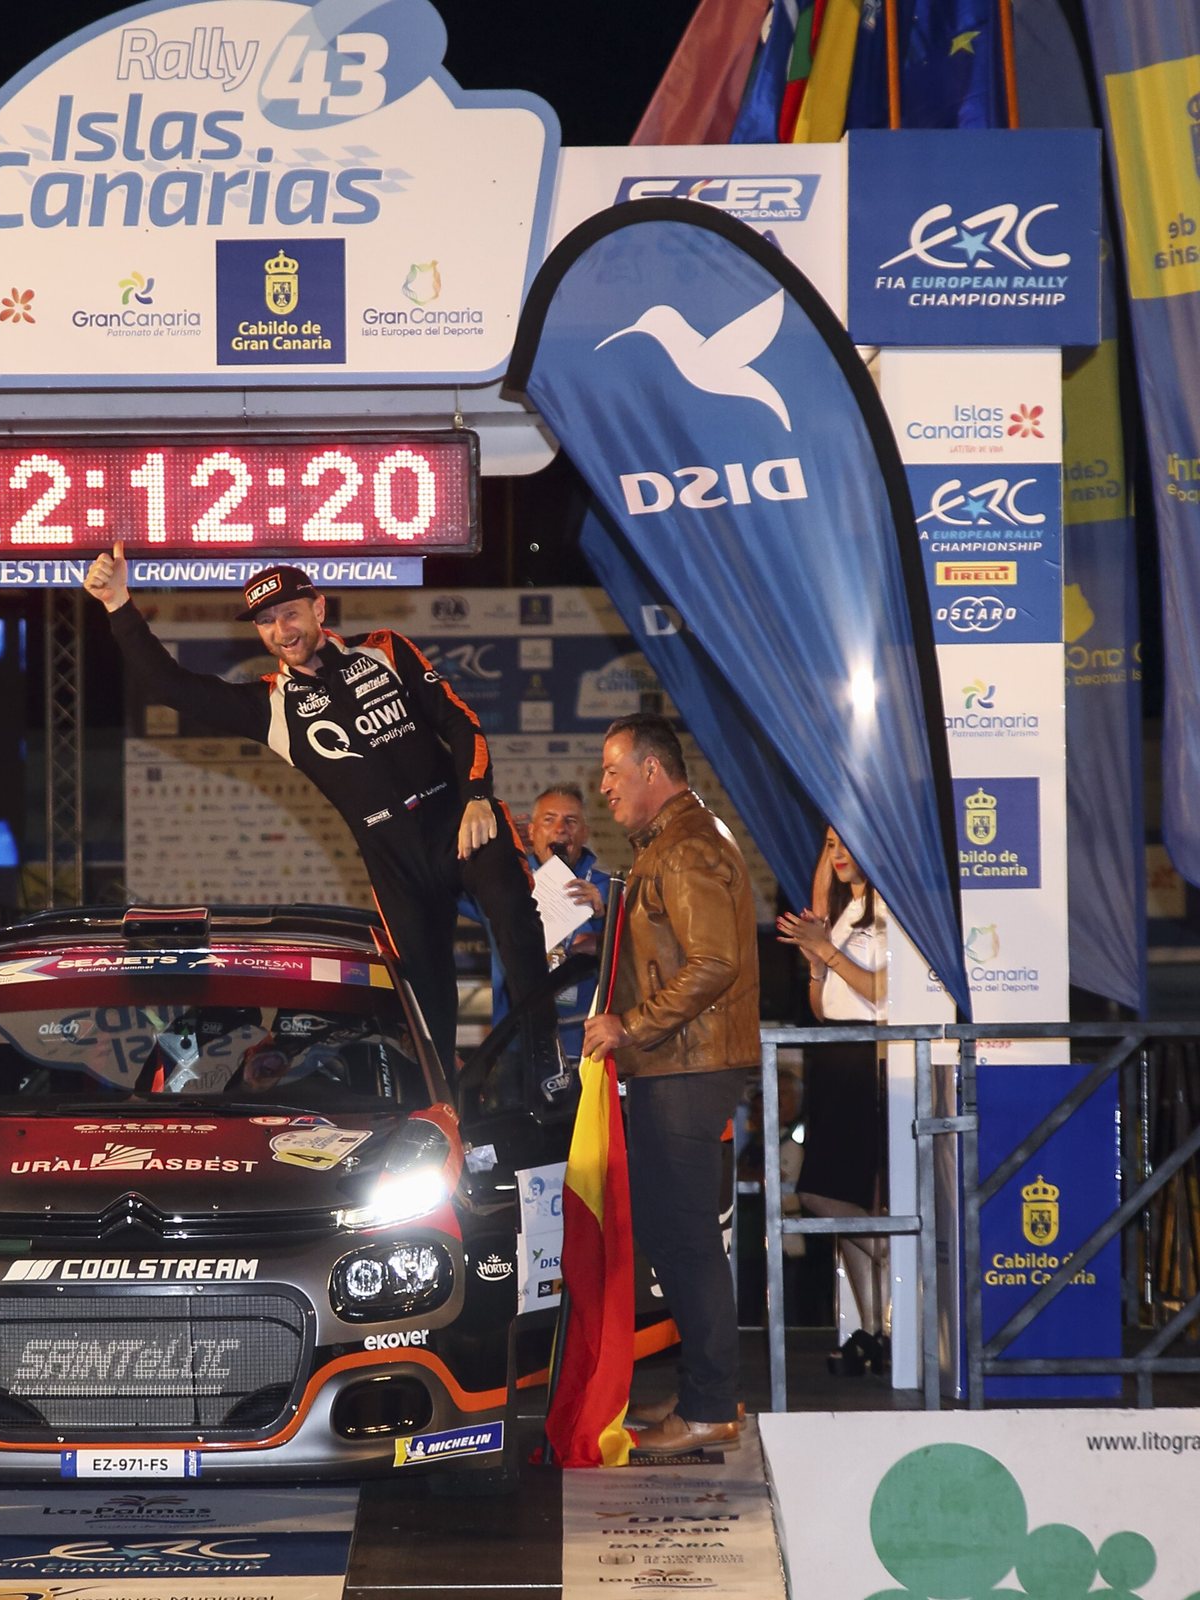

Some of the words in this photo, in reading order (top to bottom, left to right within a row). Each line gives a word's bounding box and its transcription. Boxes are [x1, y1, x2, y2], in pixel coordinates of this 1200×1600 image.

[117, 27, 259, 92] Rally
[273, 33, 389, 116] 43
[50, 93, 244, 161] Islas
[880, 203, 1071, 270] ERC
[875, 276, 906, 290] FIA
[911, 276, 1008, 290] EUROPEAN
[1012, 275, 1068, 289] RALLY
[909, 292, 1066, 307] CHAMPIONSHIP
[107, 328, 151, 337] Patronato
[153, 328, 164, 337] de
[166, 327, 201, 337] Turismo
[238, 321, 300, 336] Cabildo
[303, 320, 321, 335] de
[362, 327, 379, 336] Isla
[381, 327, 422, 337] Europea
[425, 326, 441, 336] del
[443, 326, 484, 337] Deporte
[231, 337, 269, 351] Gran
[272, 336, 332, 350] Canaria
[954, 405, 1003, 421] Islas
[907, 421, 1004, 439] Canarias
[916, 478, 1046, 526] ERC
[933, 530, 1002, 539] EUROPEAN
[1004, 529, 1044, 538] RALLY
[931, 542, 1042, 552] CHAMPIONSHIP
[134, 561, 320, 582] CRONOMETRR
[323, 561, 399, 582] OFICIAL
[944, 565, 1010, 580] PIRELLI
[248, 579, 278, 602] LUCAS
[936, 607, 1017, 620] OSCARO
[298, 695, 332, 715] HORTEX
[355, 699, 408, 735] QIWI
[369, 722, 416, 748] simplifying
[960, 851, 996, 864] bildo
[1000, 851, 1018, 864] de
[973, 864, 1028, 877] Canaria
[57, 956, 178, 970] SEAJETS
[234, 957, 303, 969] LOPESAN
[971, 967, 1039, 982] Canaria
[74, 1123, 218, 1131] octane
[10, 1159, 89, 1174] URAL
[144, 1158, 259, 1173] ASBEST
[478, 1261, 513, 1275] HORTEX
[540, 1256, 561, 1269] DIS
[992, 1253, 1058, 1269] Cabildo
[61, 1259, 259, 1281] COOLSTREAM
[985, 1271, 1026, 1285] Gran
[427, 1432, 492, 1454] MICHELIN
[66, 1452, 73, 1461] F
[93, 1458, 169, 1471] EZ-971-FS
[41, 1565, 262, 1573] CHAMPIONSHIP
